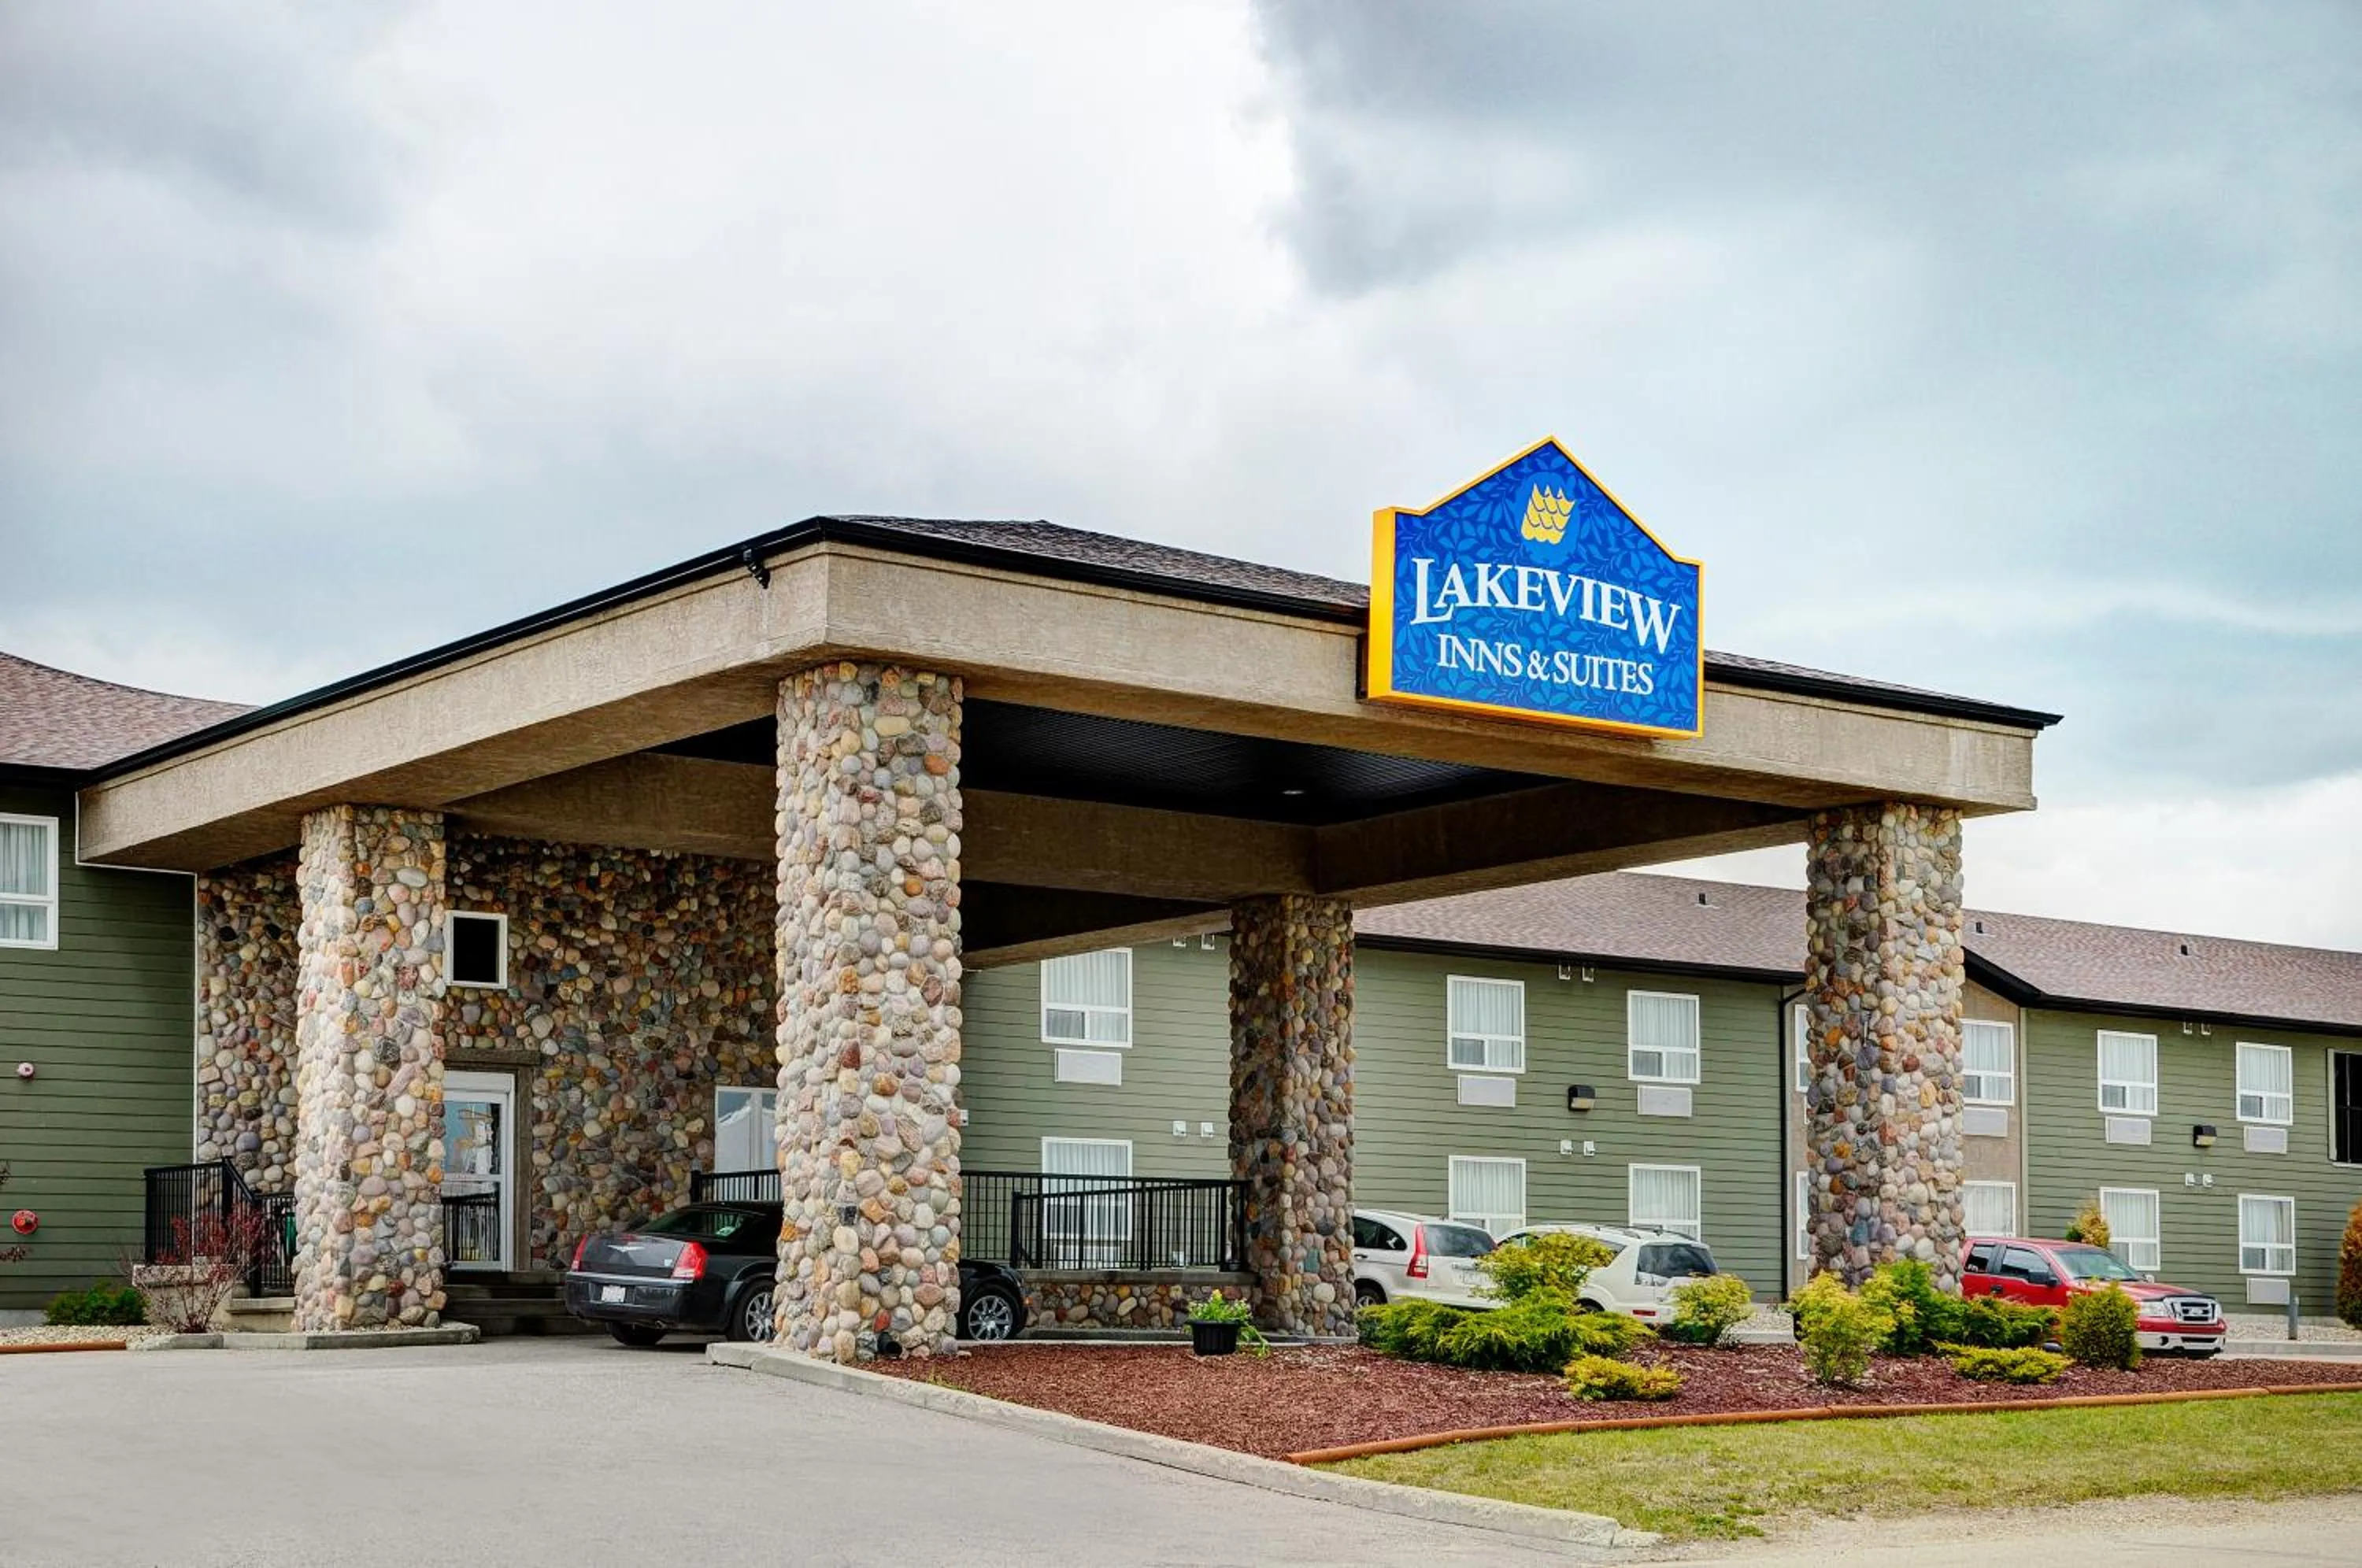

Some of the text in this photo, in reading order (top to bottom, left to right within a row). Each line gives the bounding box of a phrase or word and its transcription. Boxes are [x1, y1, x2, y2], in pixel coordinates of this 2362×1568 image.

[1410, 557, 1682, 654] LAKEVIEW
[1437, 634, 1653, 695] INNS & SUITES
